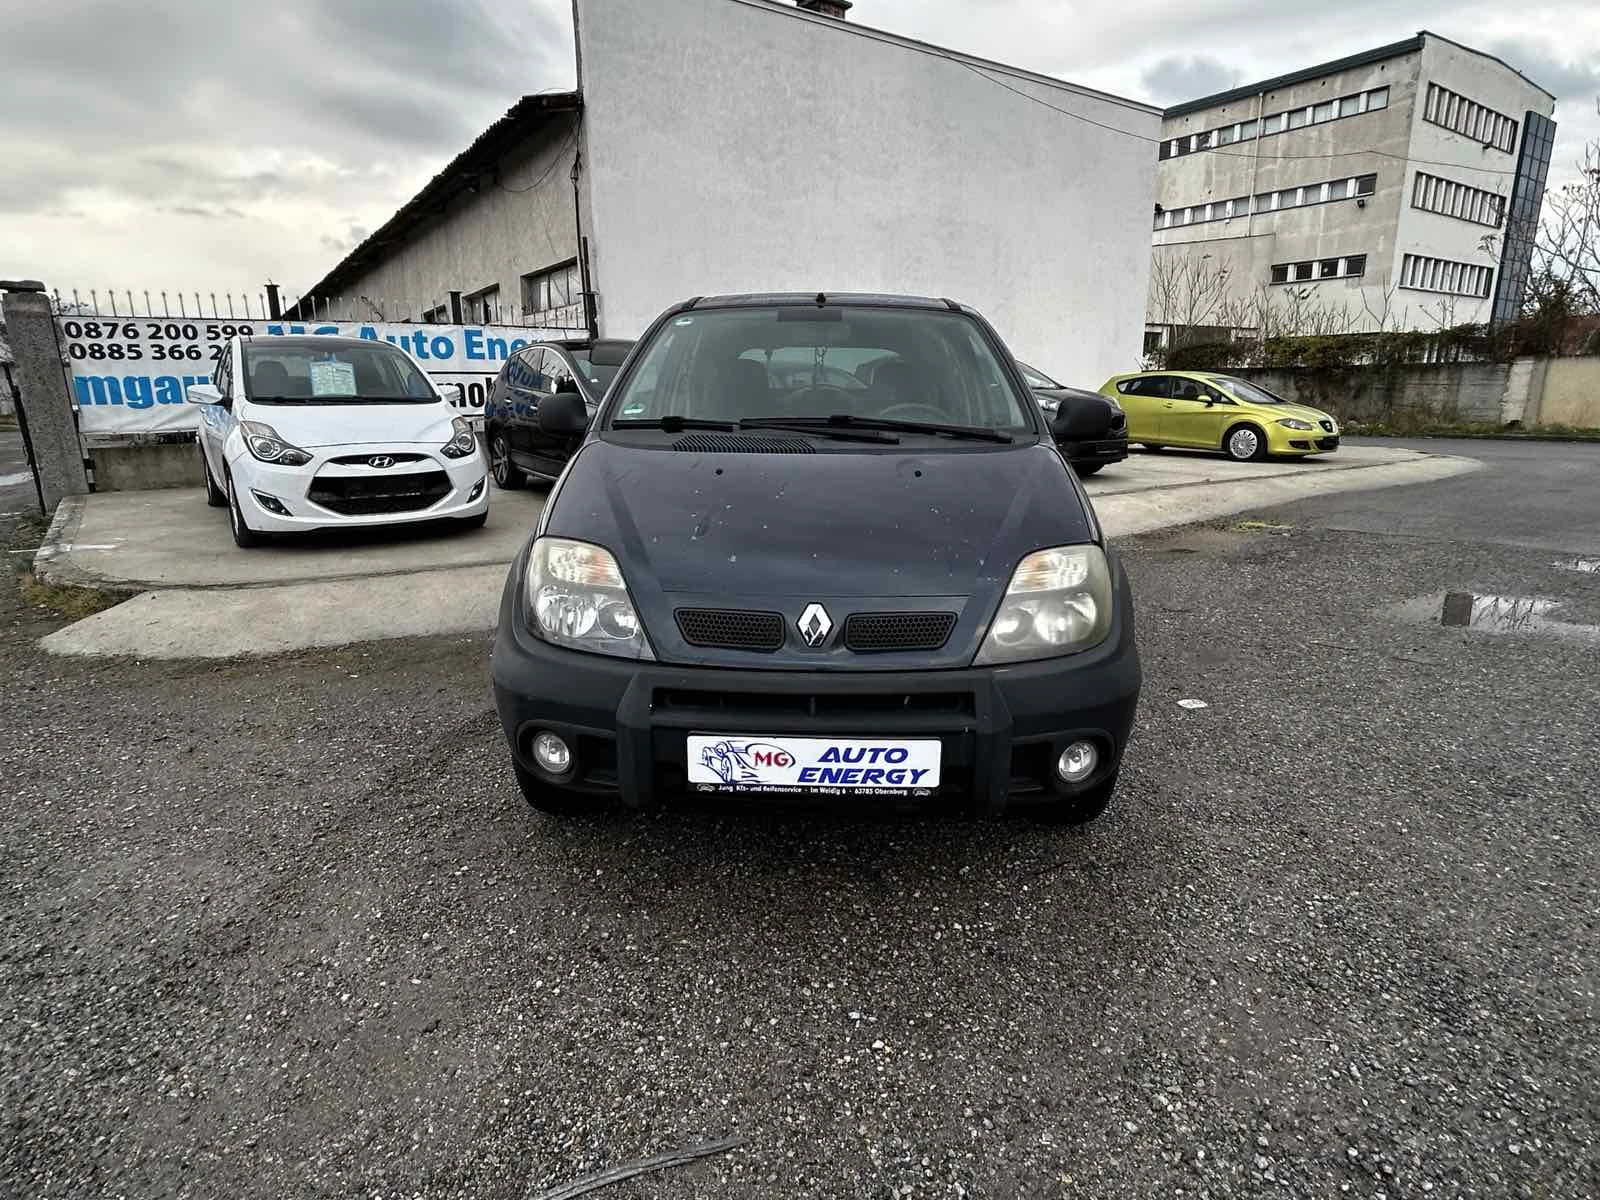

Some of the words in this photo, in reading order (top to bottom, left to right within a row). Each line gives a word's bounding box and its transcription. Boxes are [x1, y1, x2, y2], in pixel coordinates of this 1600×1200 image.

[64, 321, 139, 339] 0876
[147, 323, 198, 340] 200
[206, 325, 254, 340] 599
[68, 343, 143, 360] 0885
[151, 344, 202, 360] 366
[754, 751, 789, 767] MG
[817, 747, 909, 763] AUTO
[797, 767, 930, 784] ENERGY
